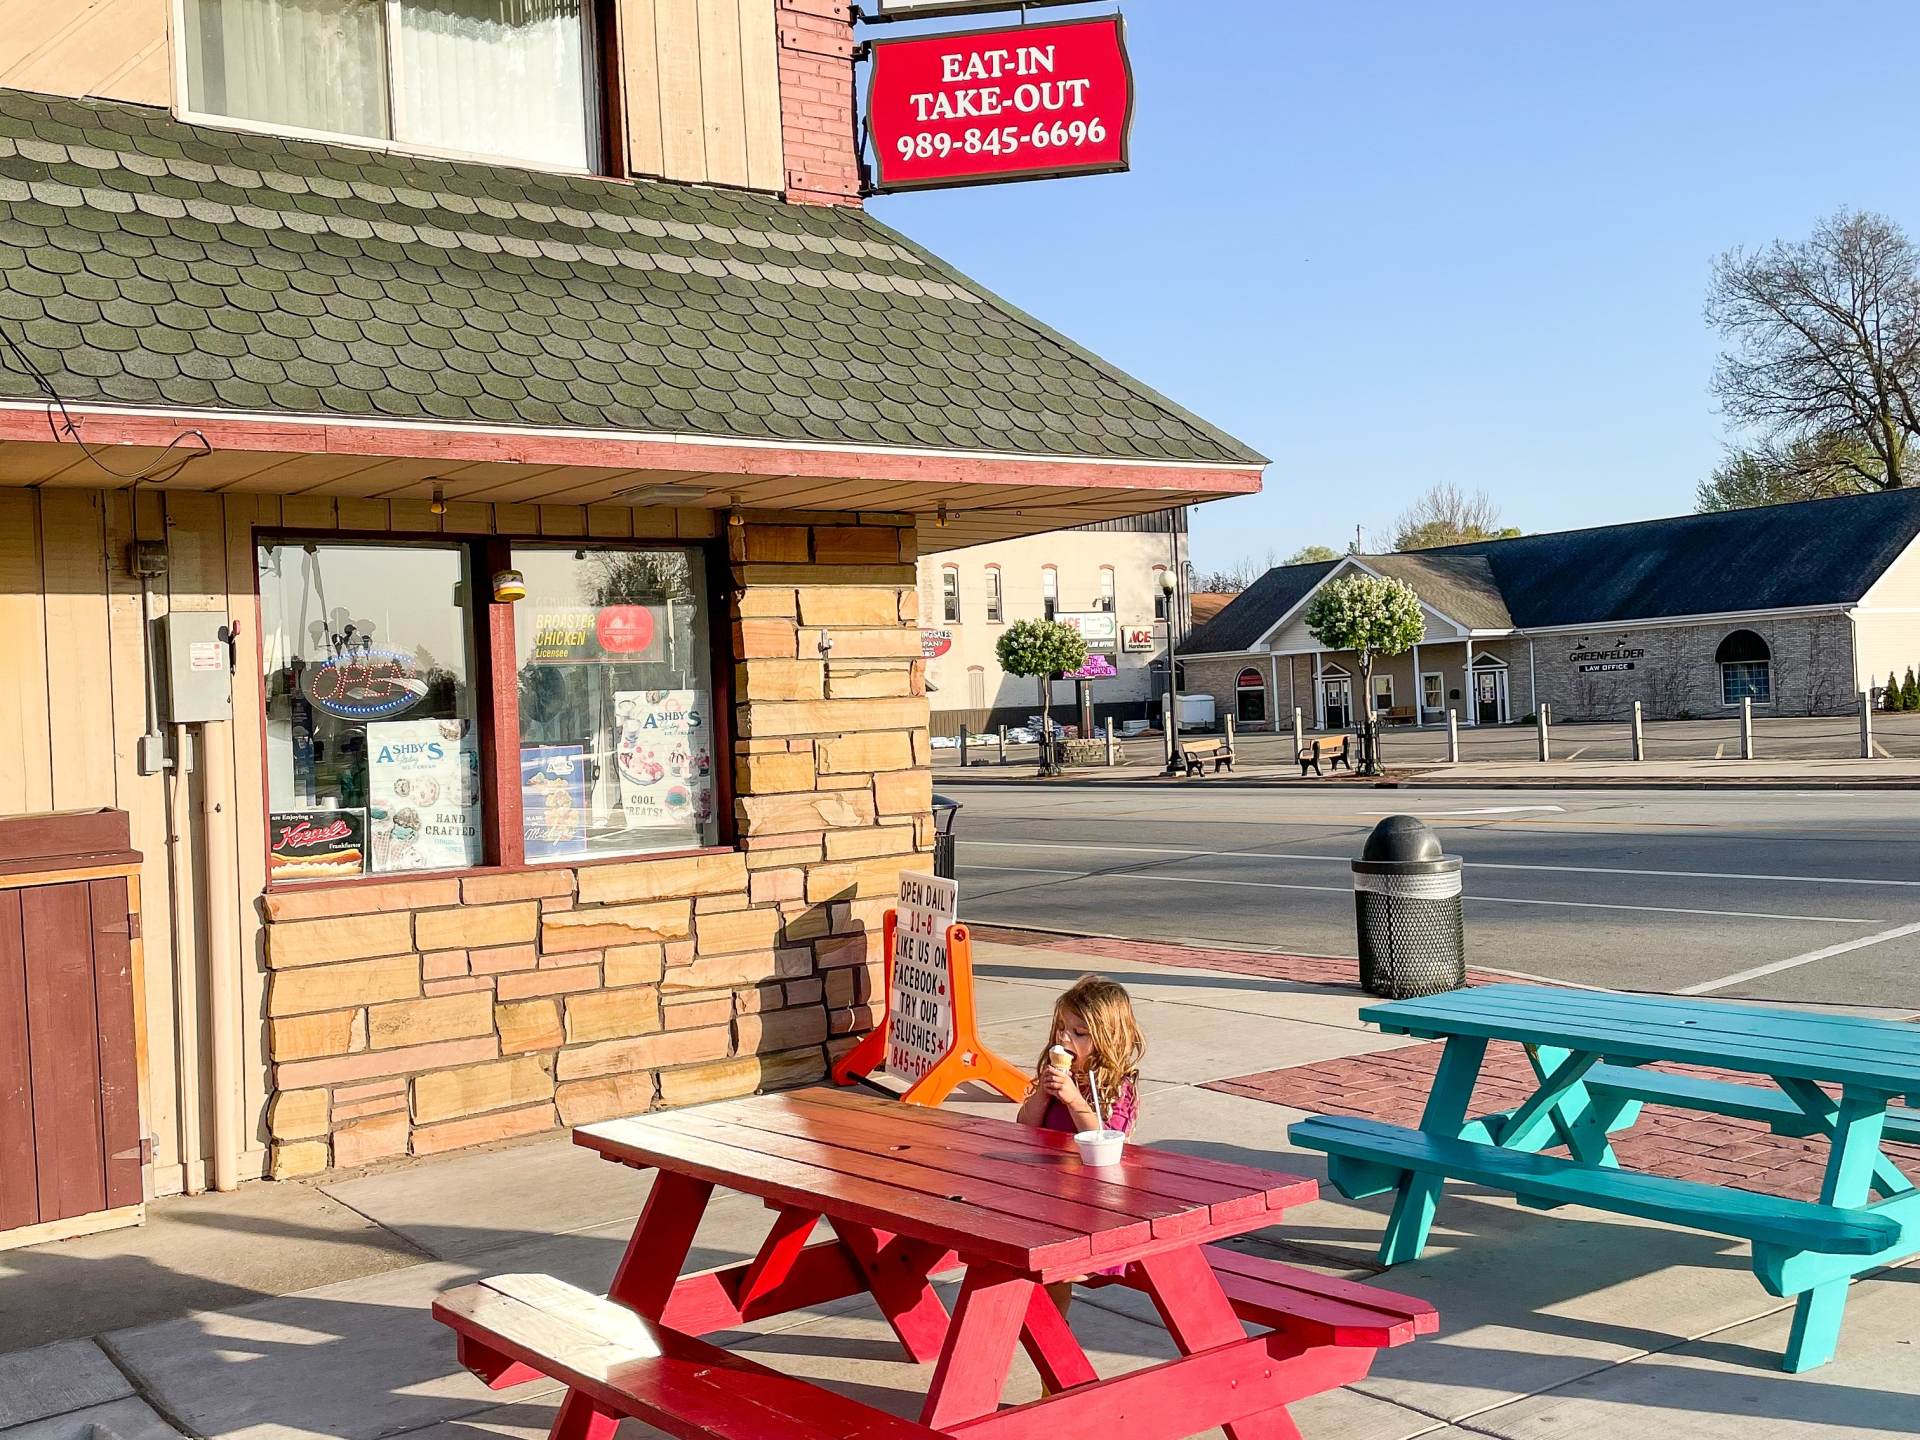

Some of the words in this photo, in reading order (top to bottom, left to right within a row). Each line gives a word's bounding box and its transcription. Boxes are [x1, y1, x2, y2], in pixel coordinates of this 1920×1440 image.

[941, 45, 1055, 82] EAT-IN
[910, 78, 1090, 121] TAKE-OUT
[897, 118, 1106, 160] 989-845-6696
[536, 614, 595, 629] BROASTER
[536, 631, 586, 646] CHICKEN
[1128, 631, 1150, 643] ACE
[536, 649, 569, 658] Licensee
[1569, 649, 1645, 662] GREENFELDER
[312, 662, 416, 700] OPEN
[643, 711, 702, 729] ASHBY'S
[376, 742, 443, 763] ASHBY'S
[631, 795, 656, 805] COOL
[282, 814, 309, 822] Enjoying
[436, 813, 466, 824] HAND
[425, 826, 476, 837] CRAFTED
[901, 881, 924, 907] OPEN
[910, 911, 934, 936] 11-8
[896, 933, 914, 960] LIKE
[918, 942, 929, 965] US
[934, 945, 947, 970] ON
[895, 961, 938, 997] FACEBOOK
[901, 992, 917, 1018] TRY
[920, 1000, 938, 1026] OUR
[895, 1018, 937, 1055] SLUSHIES
